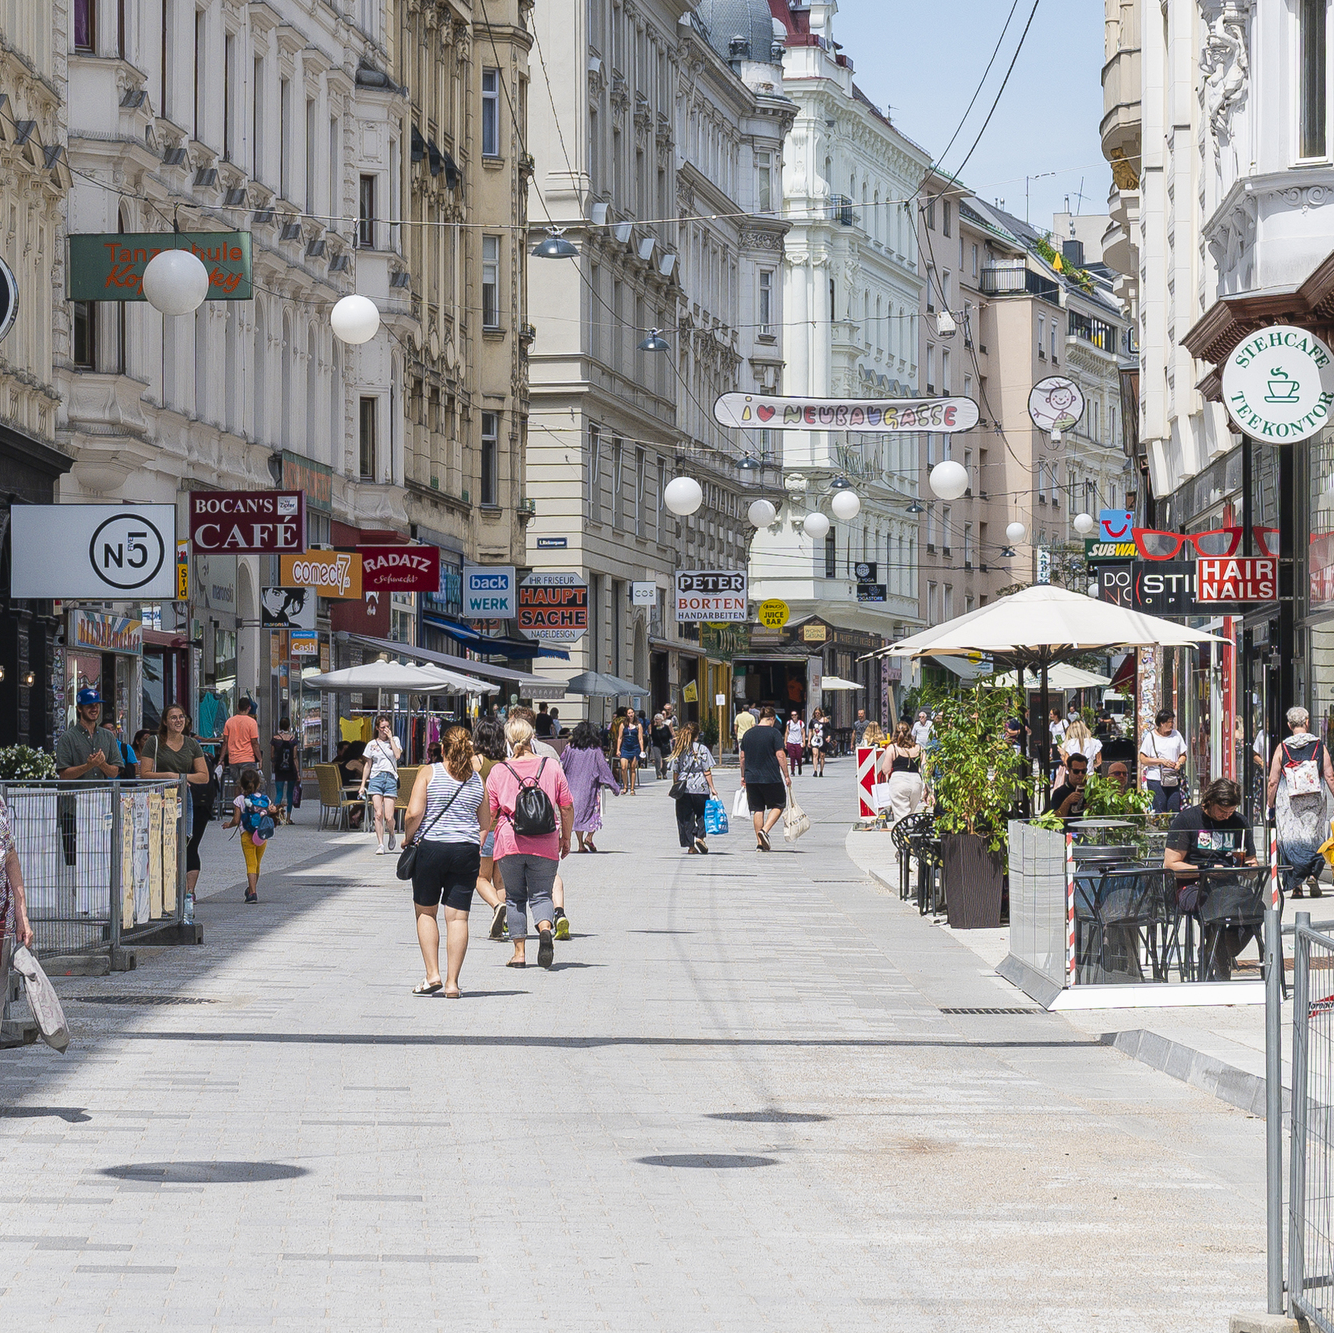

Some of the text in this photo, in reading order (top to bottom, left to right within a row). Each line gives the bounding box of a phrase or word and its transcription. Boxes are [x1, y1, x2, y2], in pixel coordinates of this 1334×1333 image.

[1235, 331, 1331, 369] STEHCAFE
[783, 403, 958, 429] NEUBAUGASSE
[1230, 390, 1334, 438] TEEKONTOR
[194, 498, 274, 515] BOCAN'S
[194, 515, 299, 549] CAFÉ
[1088, 543, 1138, 557] SUBWA
[363, 553, 432, 572] RADATZ
[1202, 560, 1274, 581] HAIR
[471, 575, 507, 589] back
[529, 576, 575, 585] IHR FRISEUR
[679, 576, 743, 590] PETER
[519, 588, 587, 604] HAUPT
[634, 589, 654, 598] COS
[1202, 581, 1273, 599] NAILS
[470, 597, 509, 610] WERK
[678, 598, 745, 610] BORTEN
[520, 610, 587, 626] SACHE
[678, 611, 745, 620] HANDARBEITEN
[763, 611, 784, 619] JUICE
[766, 618, 782, 626] BAR
[530, 630, 576, 639] NAGELDESIGN
[292, 642, 315, 653] Cash
